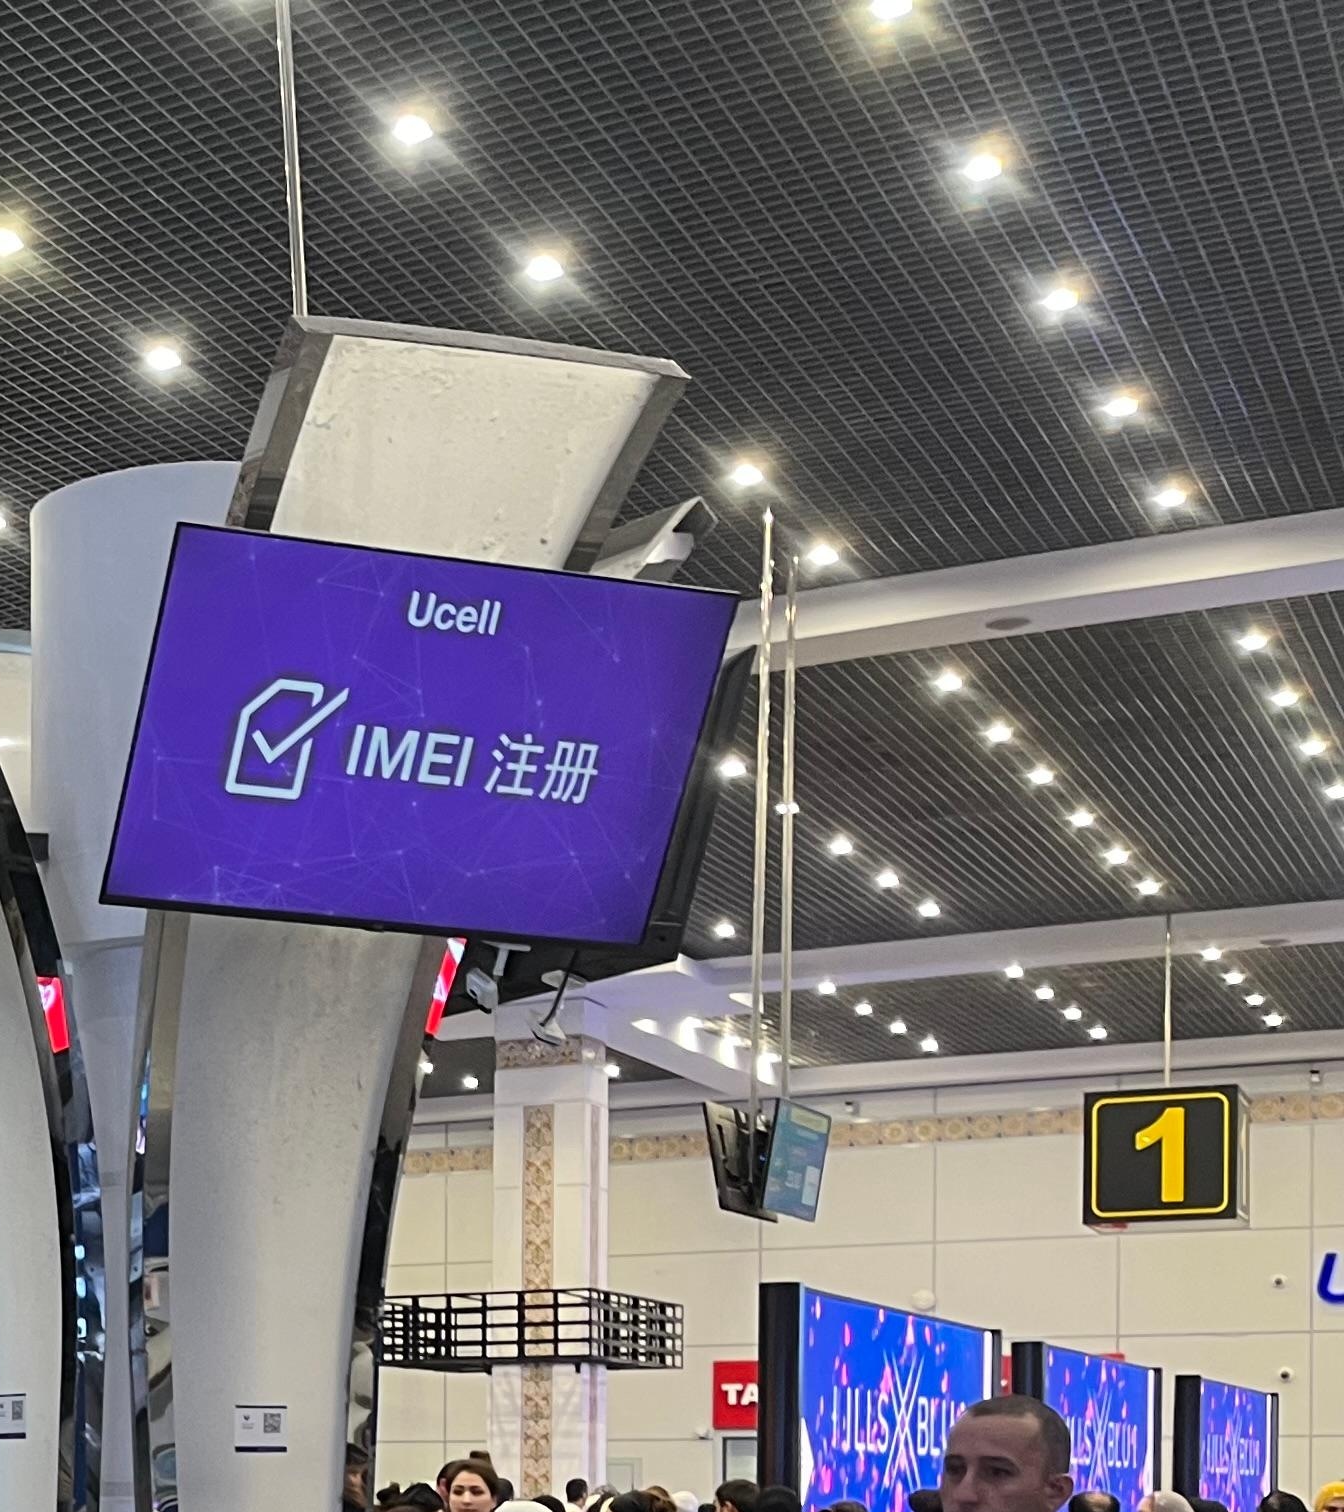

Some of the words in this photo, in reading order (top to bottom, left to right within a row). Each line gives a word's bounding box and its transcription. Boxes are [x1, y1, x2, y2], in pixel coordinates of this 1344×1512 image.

[407, 590, 500, 636] Ucell
[345, 724, 472, 787] IMEI
[482, 730, 600, 806] 注册
[1135, 1107, 1185, 1202] 1
